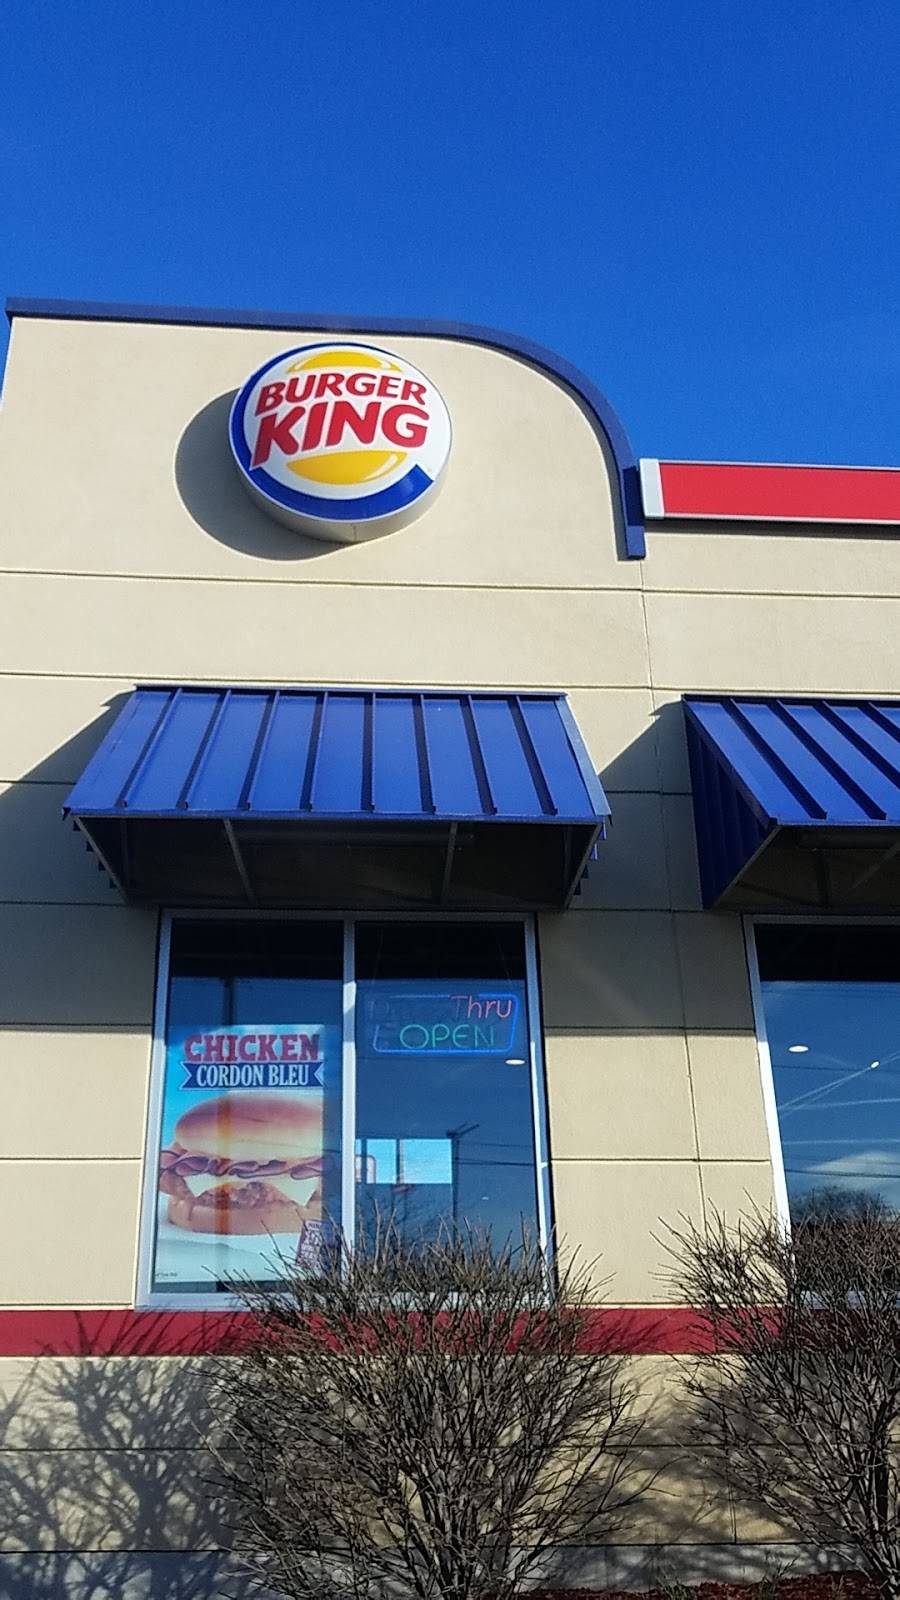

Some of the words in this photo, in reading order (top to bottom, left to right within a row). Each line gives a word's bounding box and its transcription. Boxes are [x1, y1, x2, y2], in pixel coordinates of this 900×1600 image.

[254, 372, 427, 416] BURGER
[252, 400, 430, 466] KING
[451, 995, 513, 1019] Thru
[184, 1034, 321, 1062] CHICKEN
[400, 1024, 495, 1049] OPEN
[196, 1064, 264, 1087] CORDON
[268, 1065, 309, 1086] BLEU
